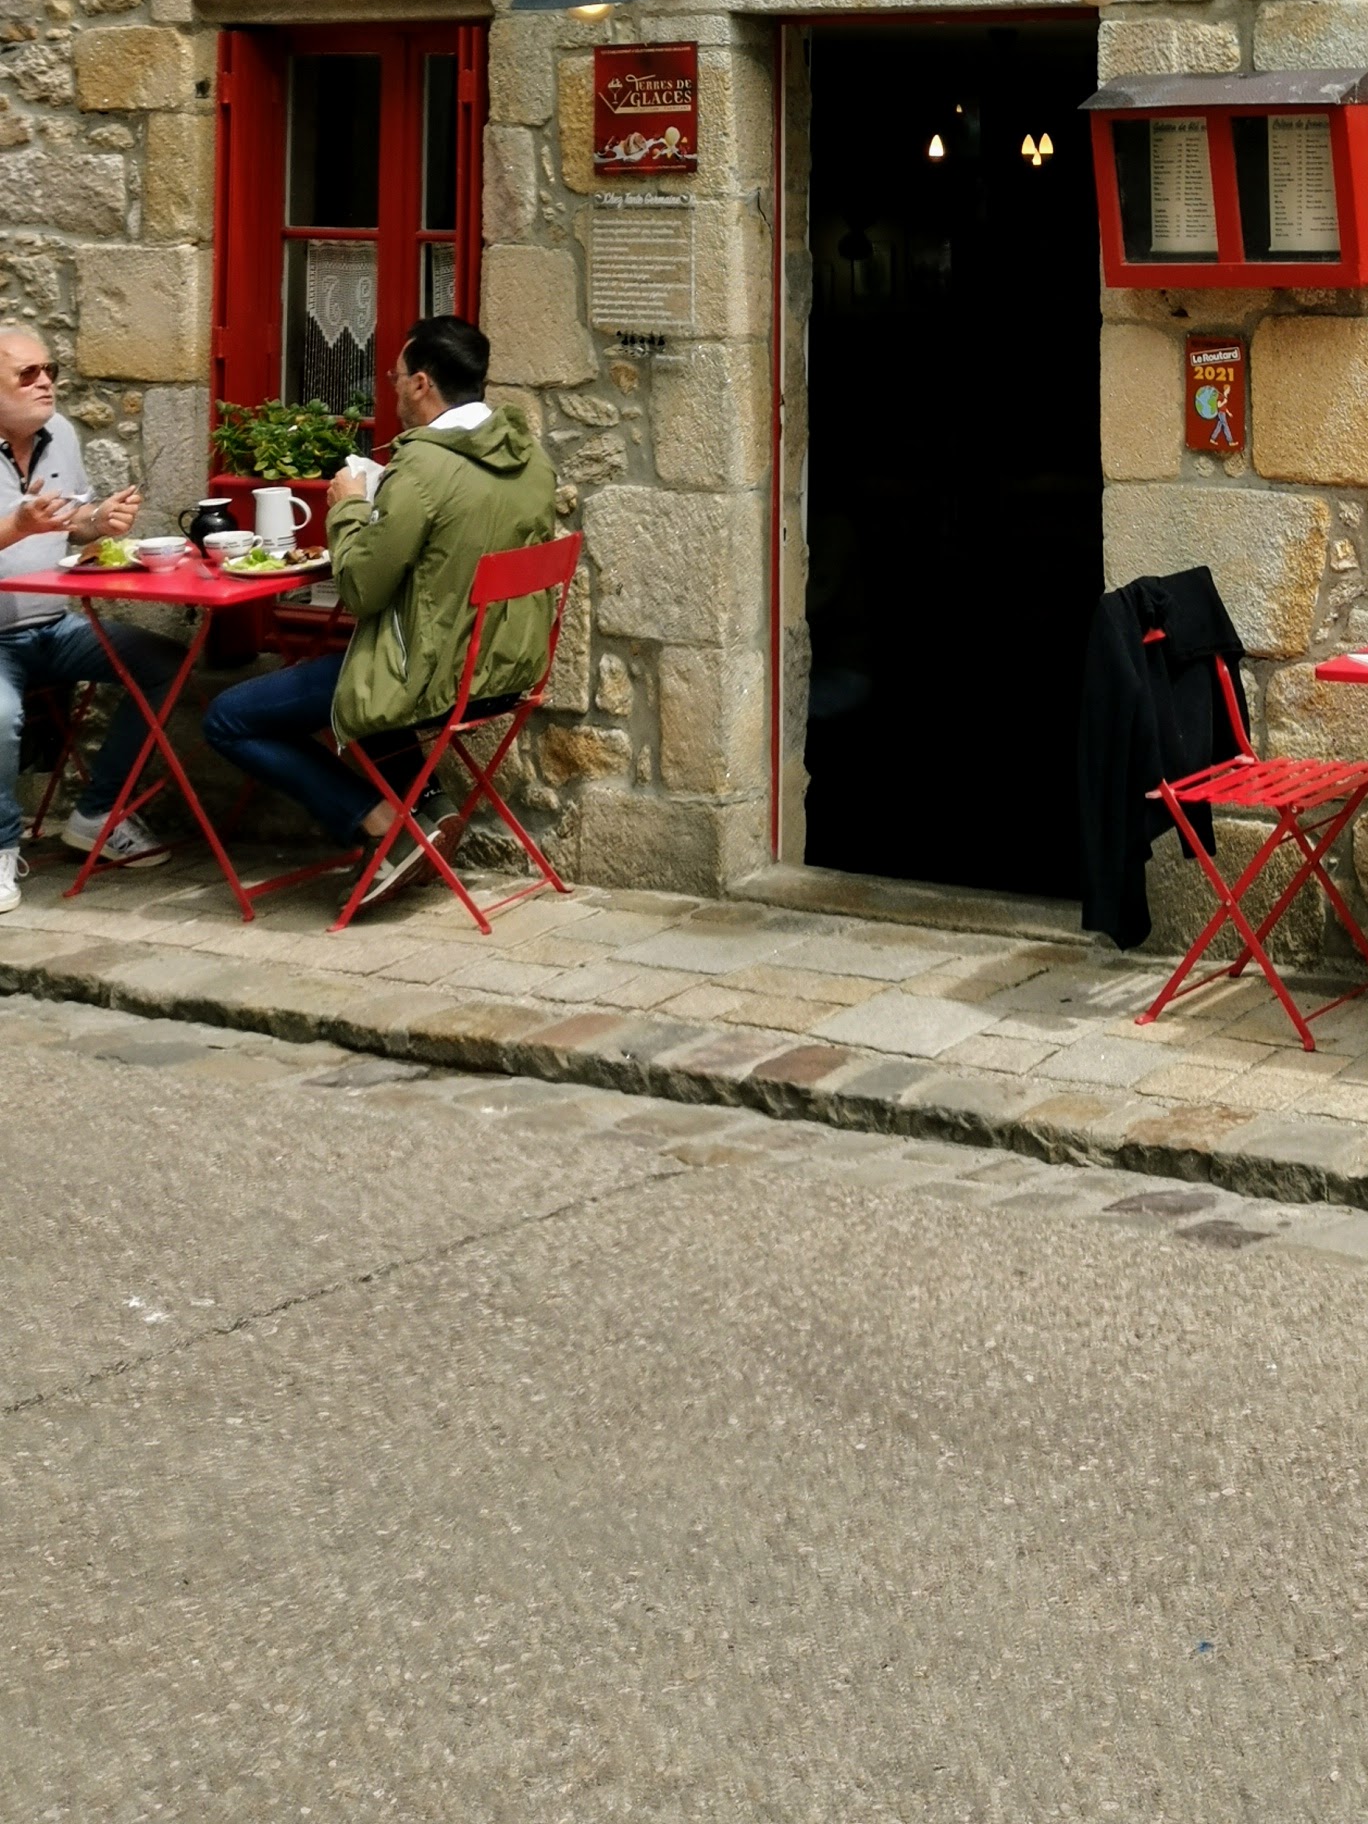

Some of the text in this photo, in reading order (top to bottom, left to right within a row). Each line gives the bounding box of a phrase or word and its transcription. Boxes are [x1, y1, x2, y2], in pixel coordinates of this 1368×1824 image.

[630, 90, 692, 107] GLACES
[644, 193, 681, 204] Germaine
[1193, 366, 1235, 382] 2021
